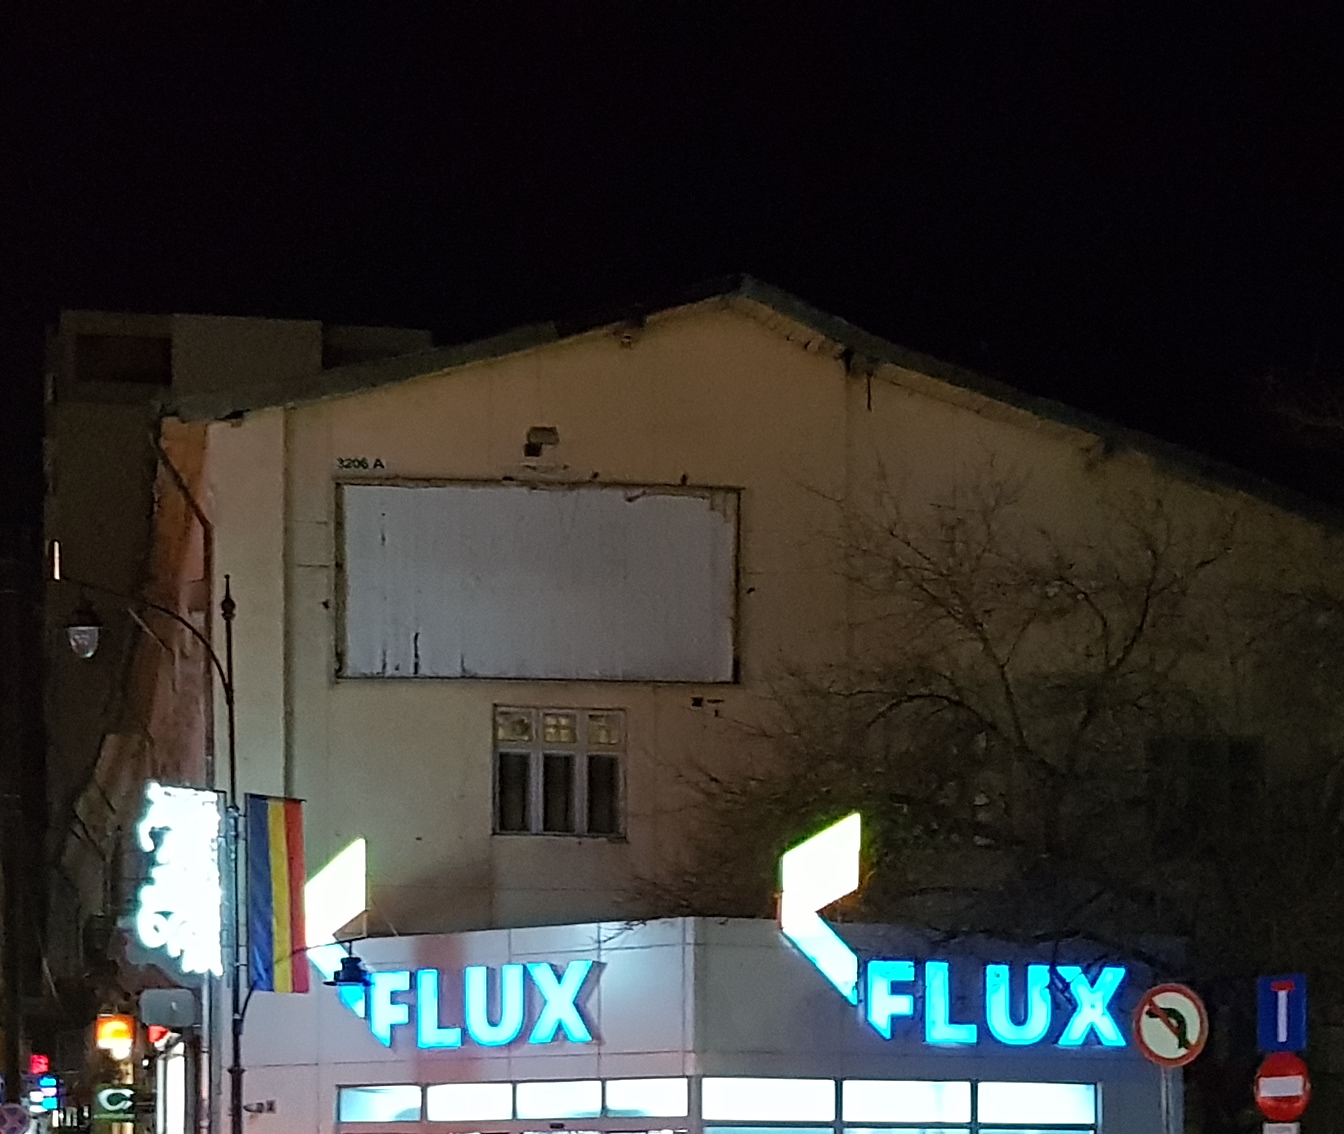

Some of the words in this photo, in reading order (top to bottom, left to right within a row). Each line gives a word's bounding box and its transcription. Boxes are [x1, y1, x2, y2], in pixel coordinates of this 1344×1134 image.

[373, 458, 385, 469] A
[370, 959, 594, 1048] FLUX
[867, 960, 1127, 1047] FLUX
